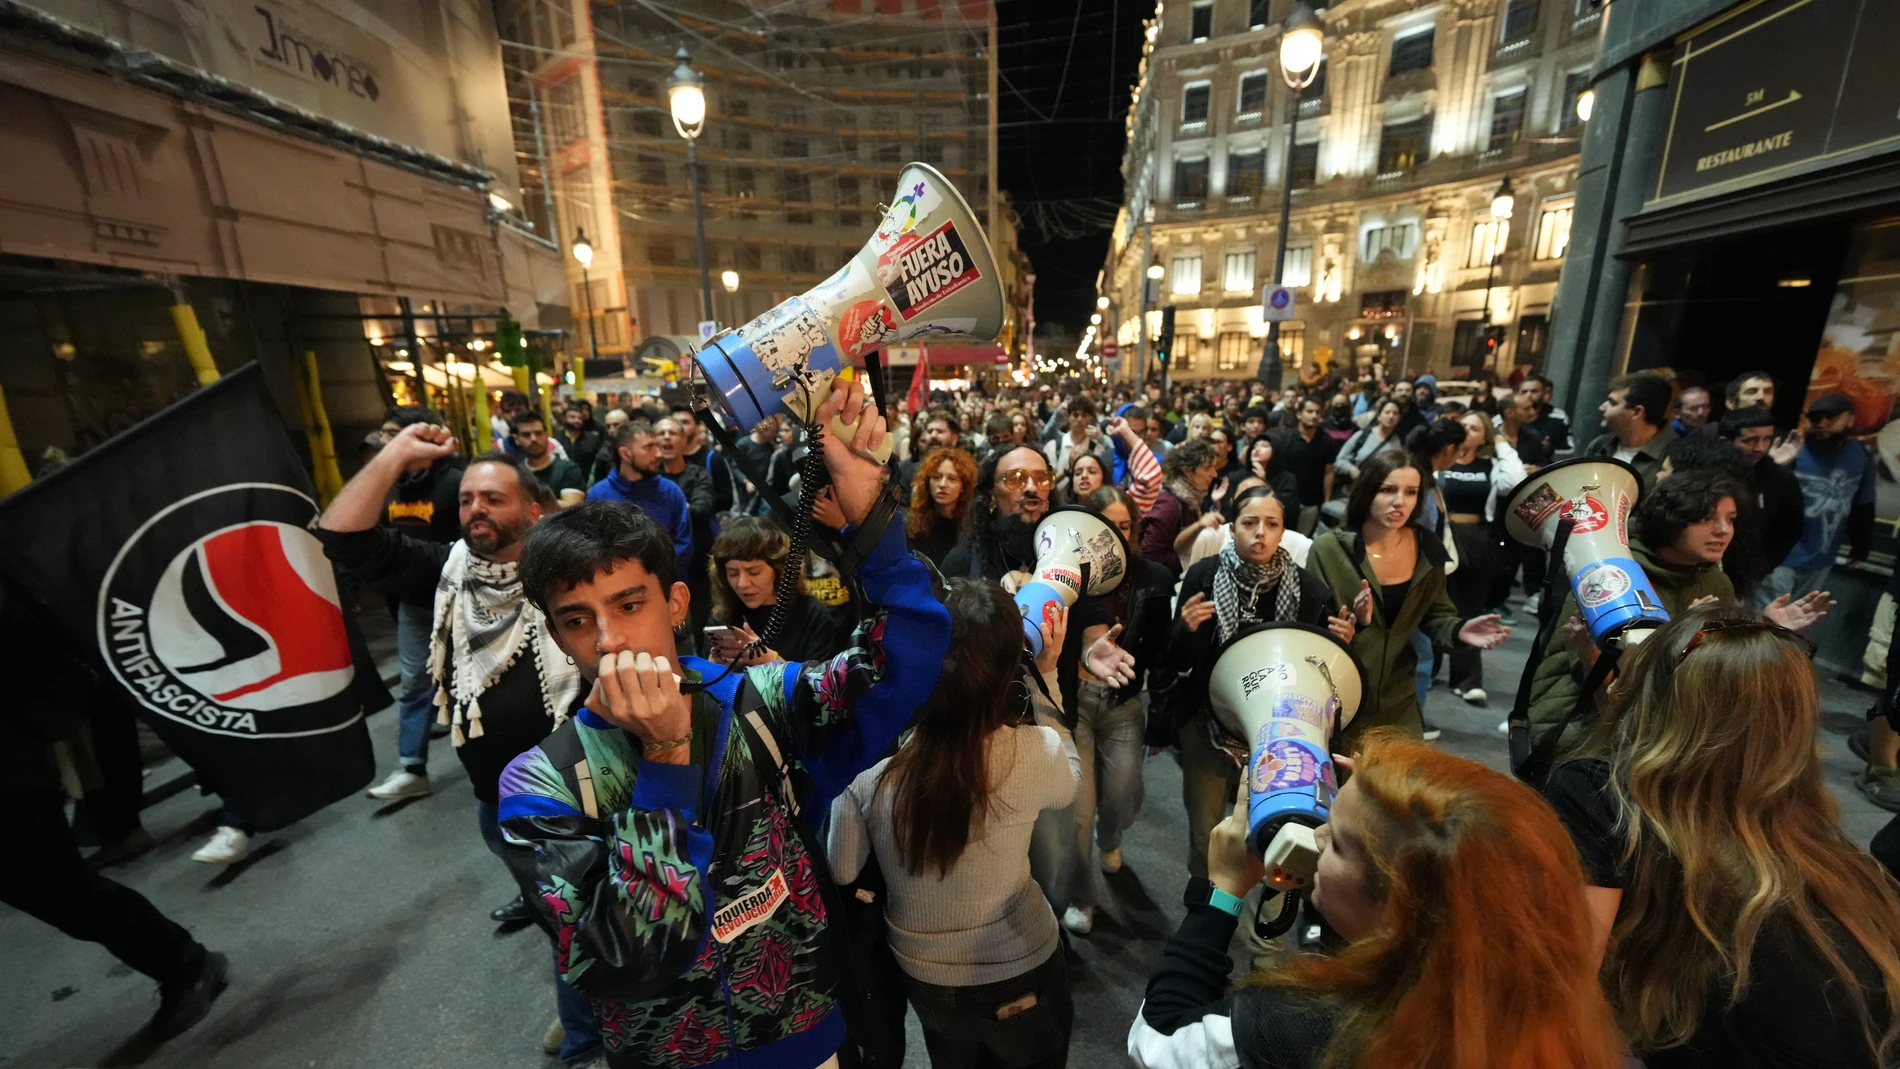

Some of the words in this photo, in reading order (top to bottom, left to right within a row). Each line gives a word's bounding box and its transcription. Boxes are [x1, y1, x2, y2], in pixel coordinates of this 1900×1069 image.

[1696, 130, 1794, 172] RESTAURANTE
[900, 230, 952, 283] FUERA
[906, 251, 964, 307] AYUSO
[914, 294, 936, 312] Sindicato
[942, 276, 971, 296] Estudiantes
[110, 597, 257, 732] ANTIFASCISTA
[1249, 671, 1260, 692] GUE
[1257, 668, 1267, 682] LA
[1276, 664, 1288, 680] NO
[1283, 747, 1302, 781] LISTA
[712, 886, 772, 929] IZQUIERDA
[715, 884, 786, 939] REVOLUCIONARIA
